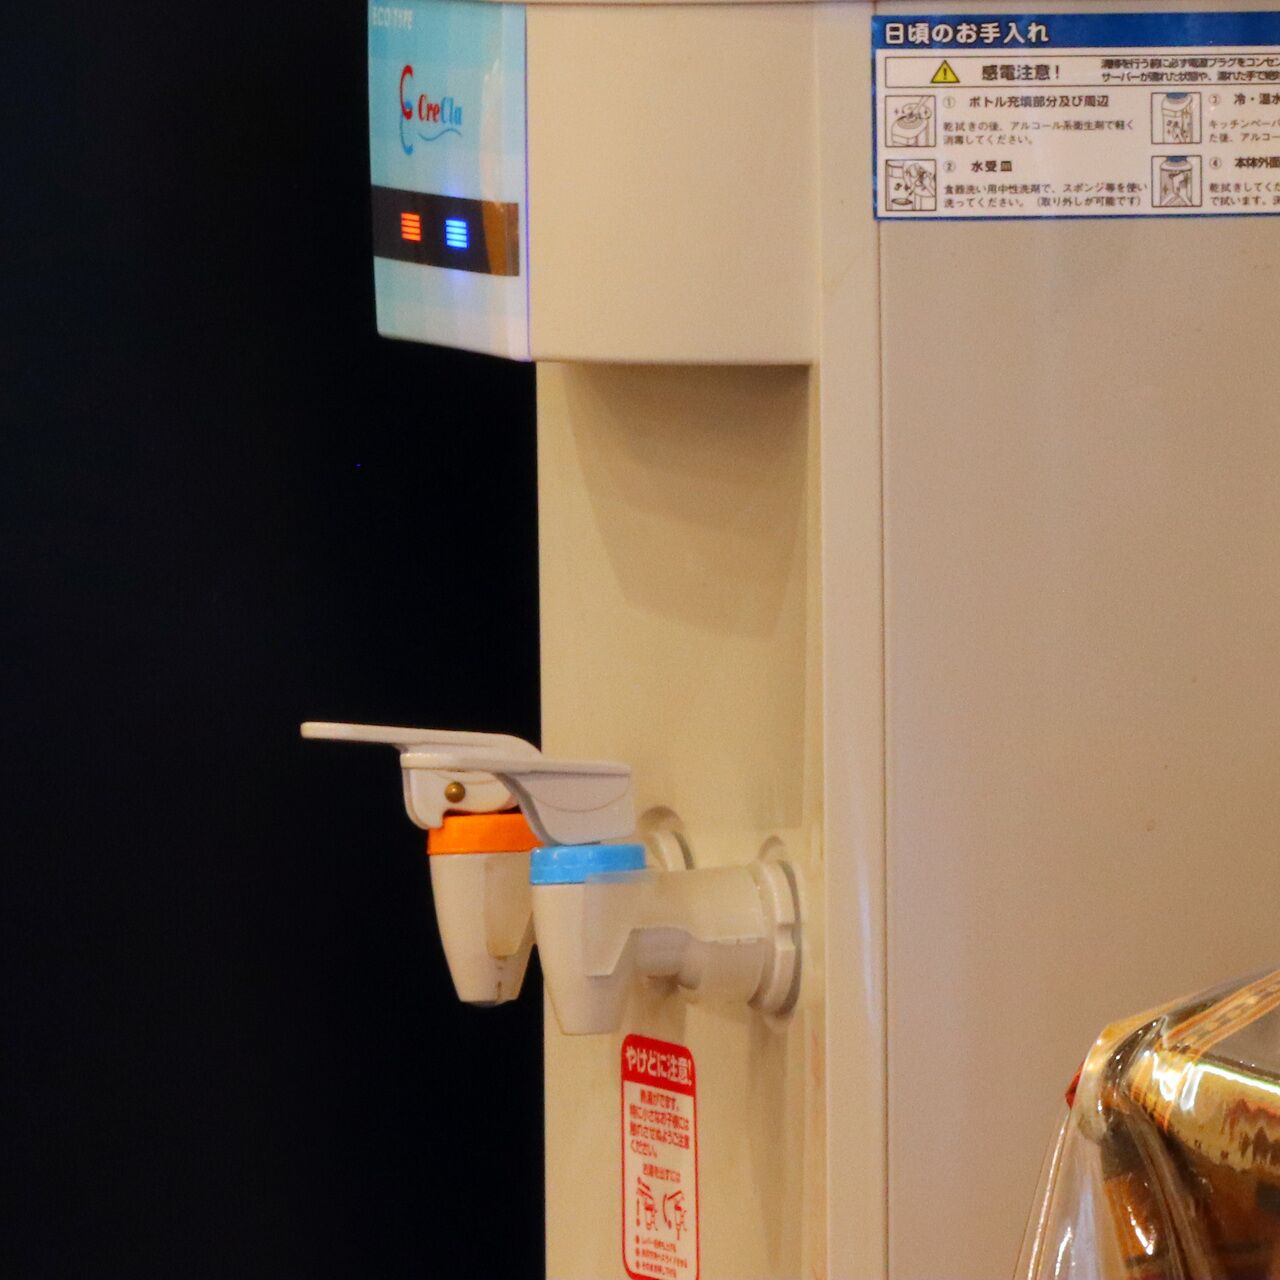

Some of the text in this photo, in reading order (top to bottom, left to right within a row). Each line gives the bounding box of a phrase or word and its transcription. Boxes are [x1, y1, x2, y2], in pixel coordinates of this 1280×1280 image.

[885, 22, 1049, 45] 日頃のお手入れ
